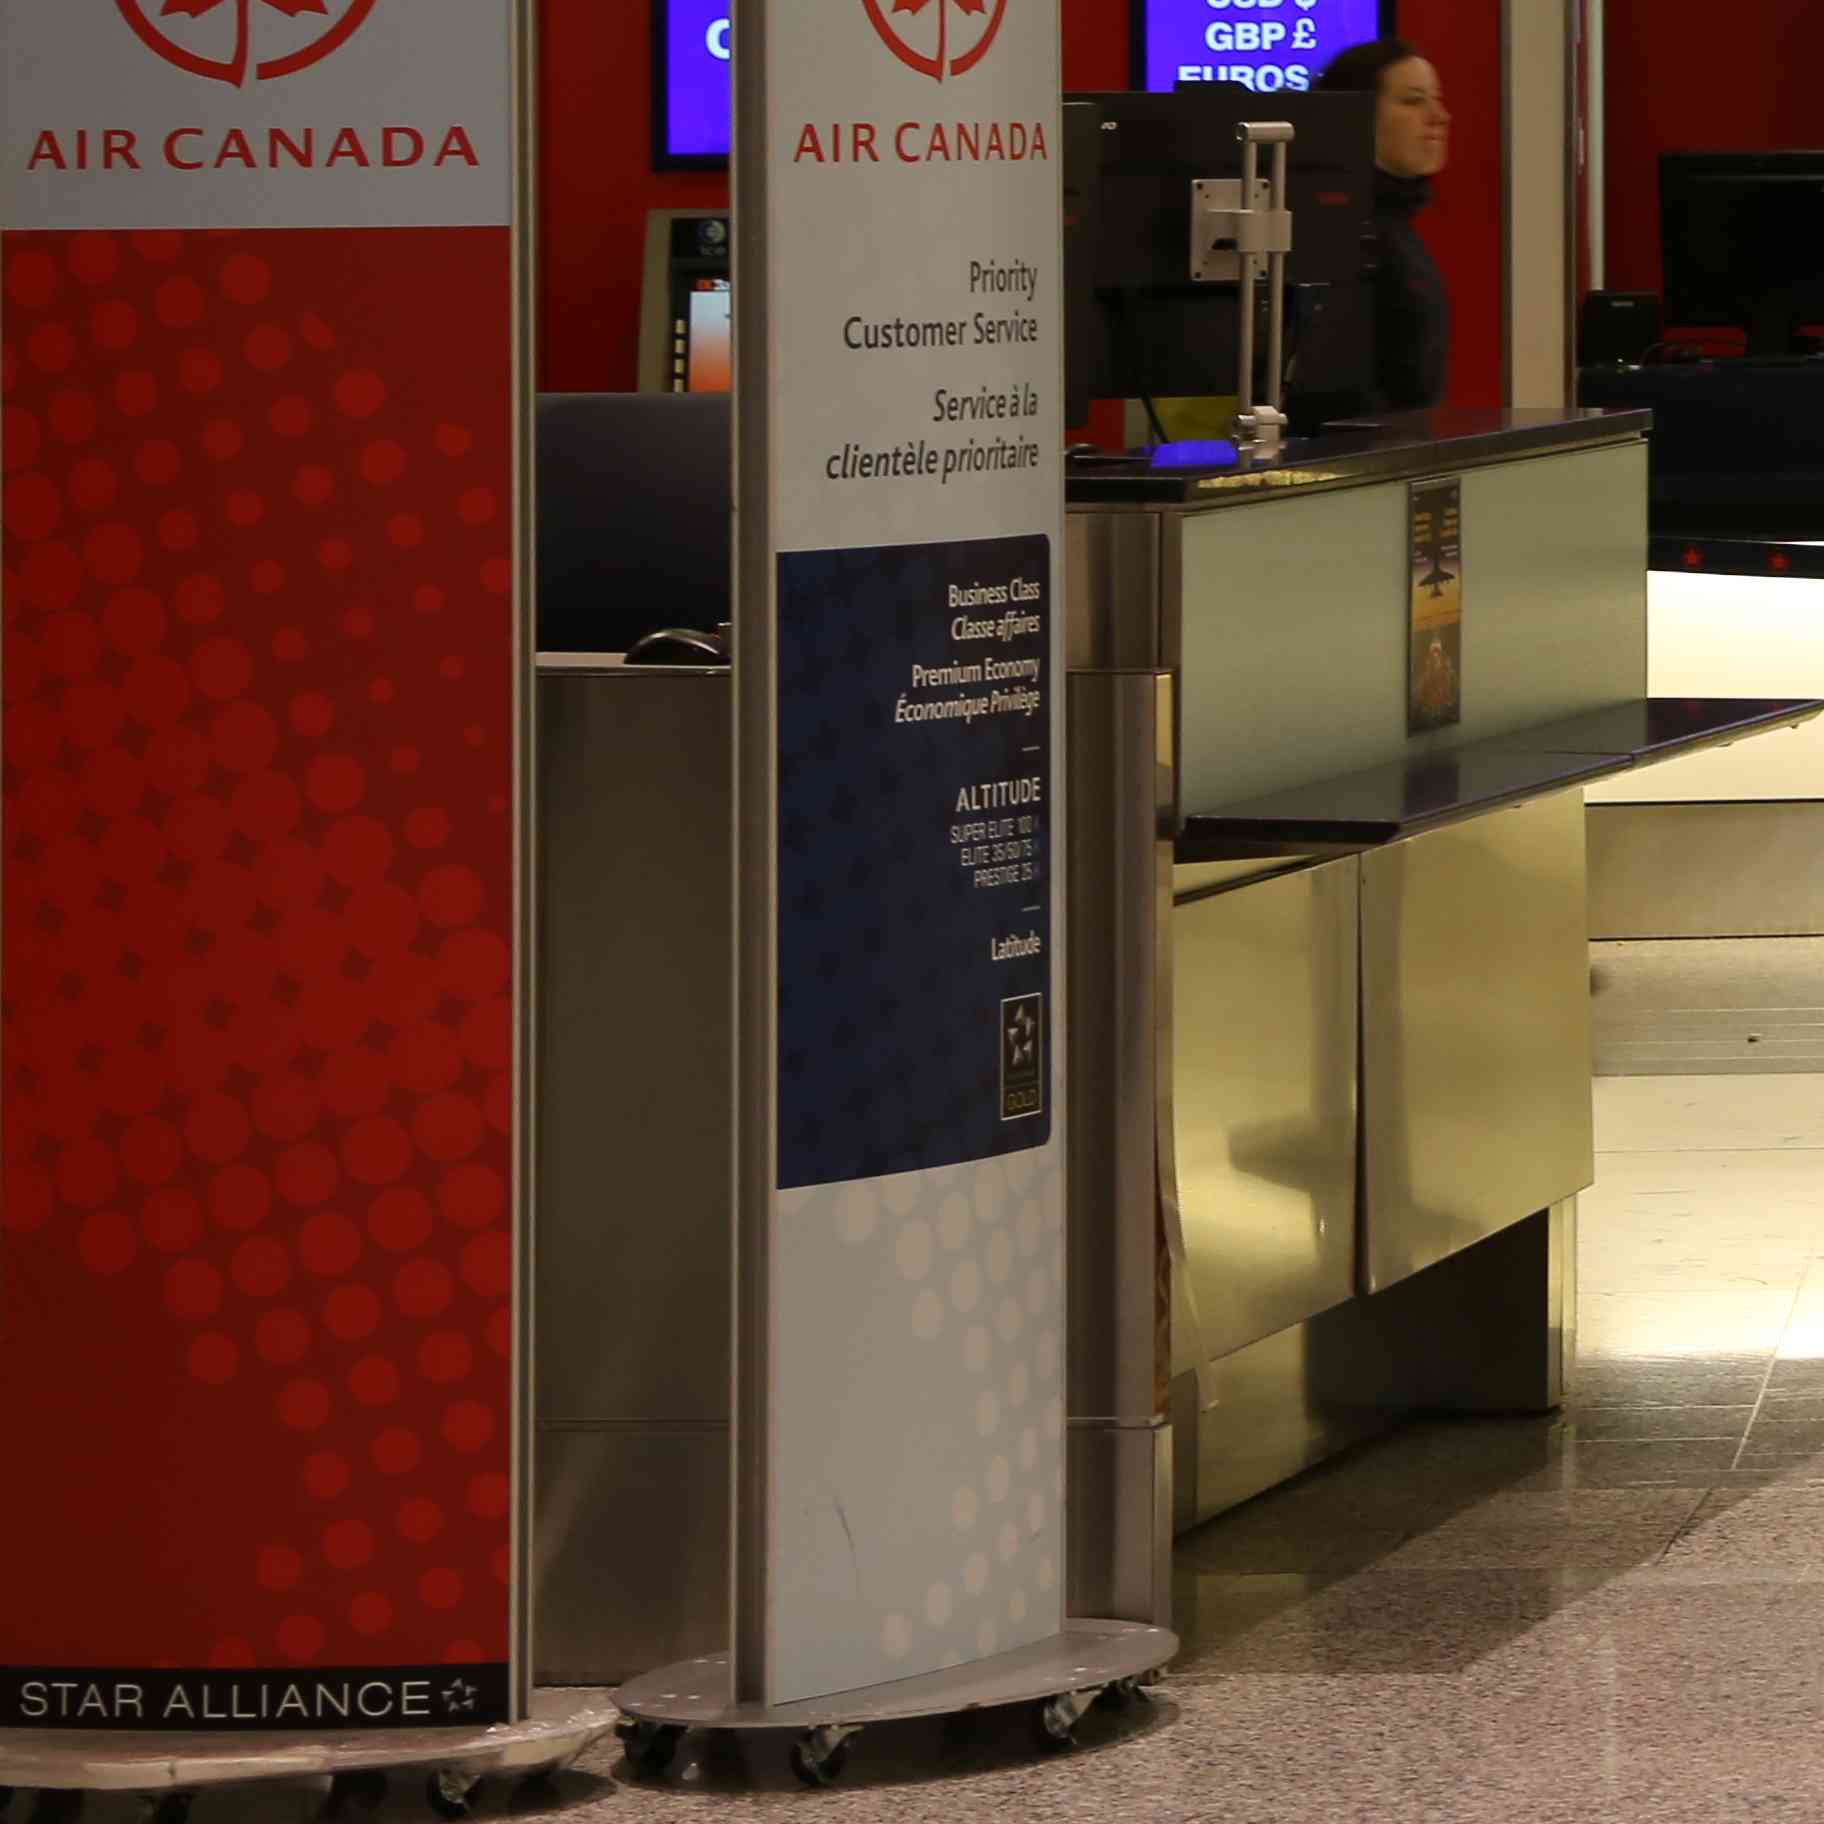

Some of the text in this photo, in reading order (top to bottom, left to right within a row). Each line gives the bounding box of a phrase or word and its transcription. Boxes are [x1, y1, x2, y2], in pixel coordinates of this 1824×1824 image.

[1205, 18, 1317, 51] GBP £
[27, 126, 480, 170] AIR CANADA
[794, 121, 1047, 162] AIR CANADA
[970, 260, 1037, 301] Priority
[844, 311, 1037, 350] Customer Service
[934, 382, 1037, 423] Service à la
[827, 439, 1038, 484] clientèle prioritaire
[949, 577, 1040, 608] Business Class
[952, 615, 995, 640] Classe
[912, 657, 1040, 687] Premium Economy
[895, 692, 988, 724] Économique
[956, 777, 1040, 812] ALTITUDE
[951, 821, 986, 844] SUPER
[992, 930, 1040, 960] Latitude
[20, 1680, 431, 1718] STAR ALLIANCE
